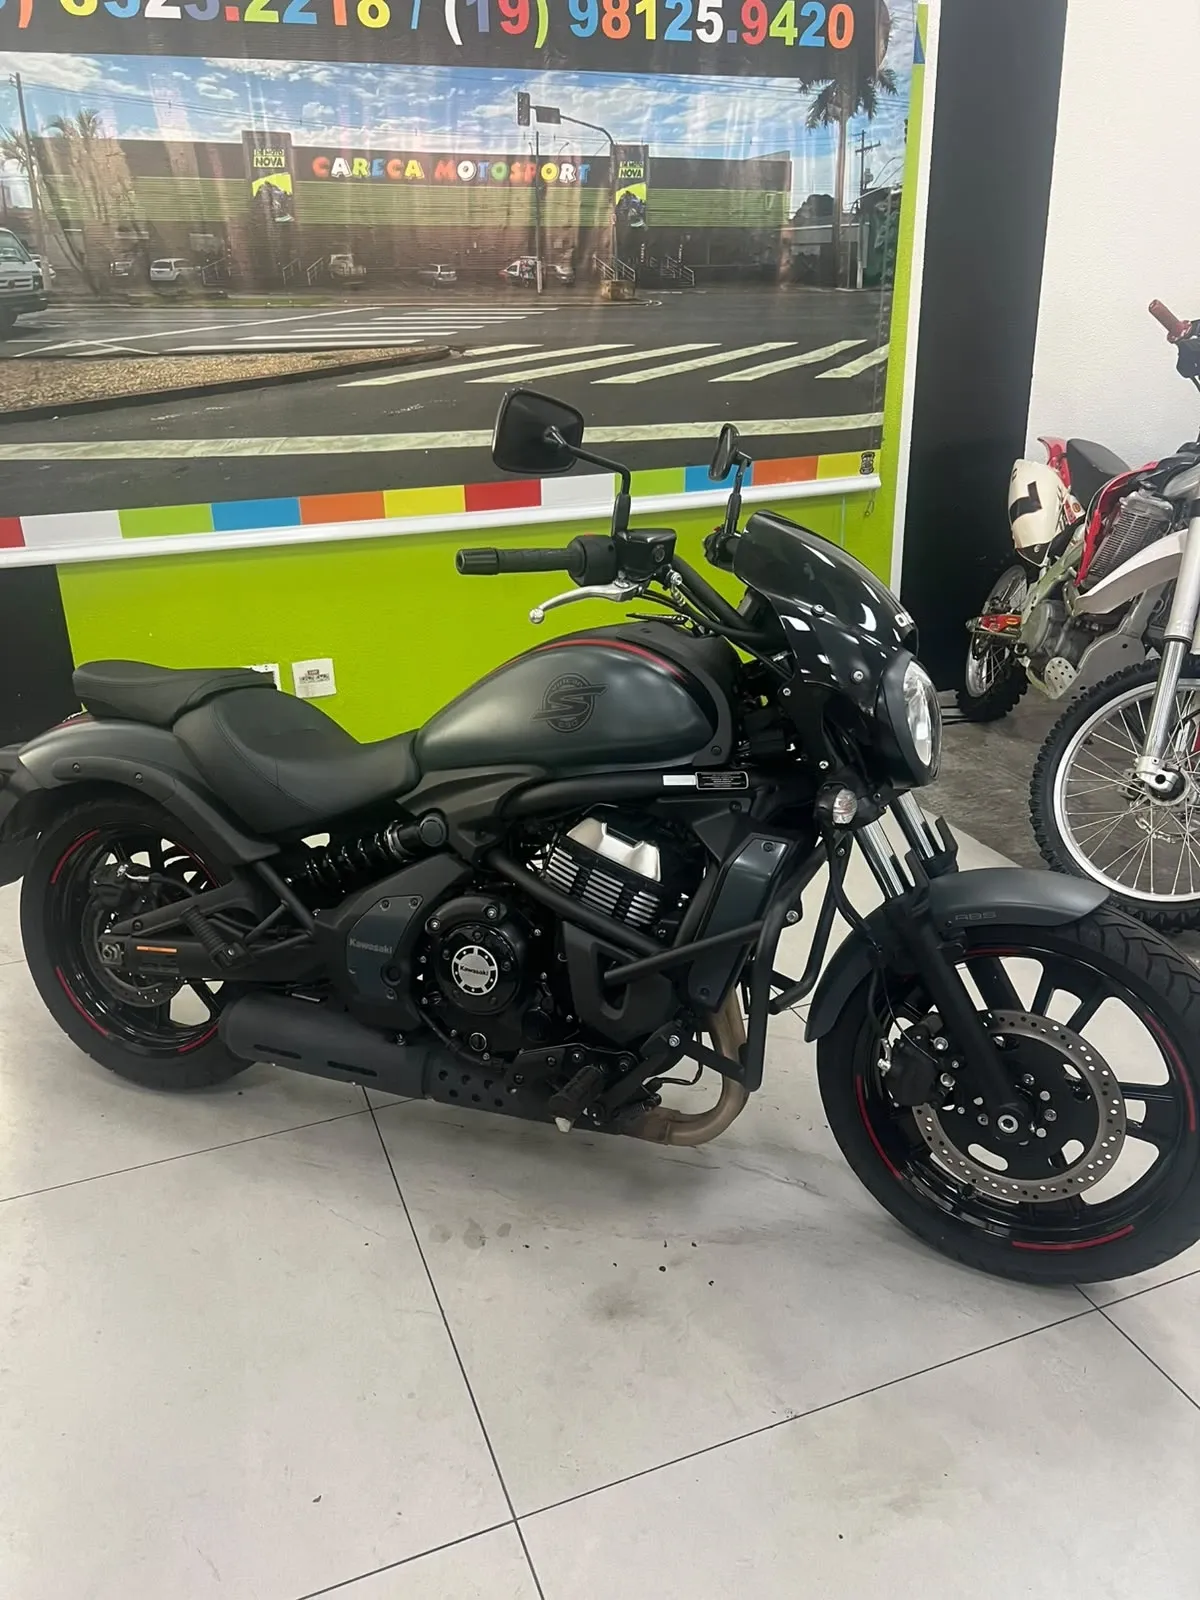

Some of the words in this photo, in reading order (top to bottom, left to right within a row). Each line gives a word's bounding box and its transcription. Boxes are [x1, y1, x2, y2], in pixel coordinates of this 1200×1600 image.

[569, 0, 854, 49] 98125.9420
[255, 157, 283, 166] NOVA
[312, 157, 425, 179] CARECA
[434, 160, 591, 183] MOTOSPORT
[620, 168, 642, 177] NOVA
[954, 911, 997, 921] ABS
[349, 937, 393, 954] Kawasaki
[459, 964, 489, 976] Kawasaki
